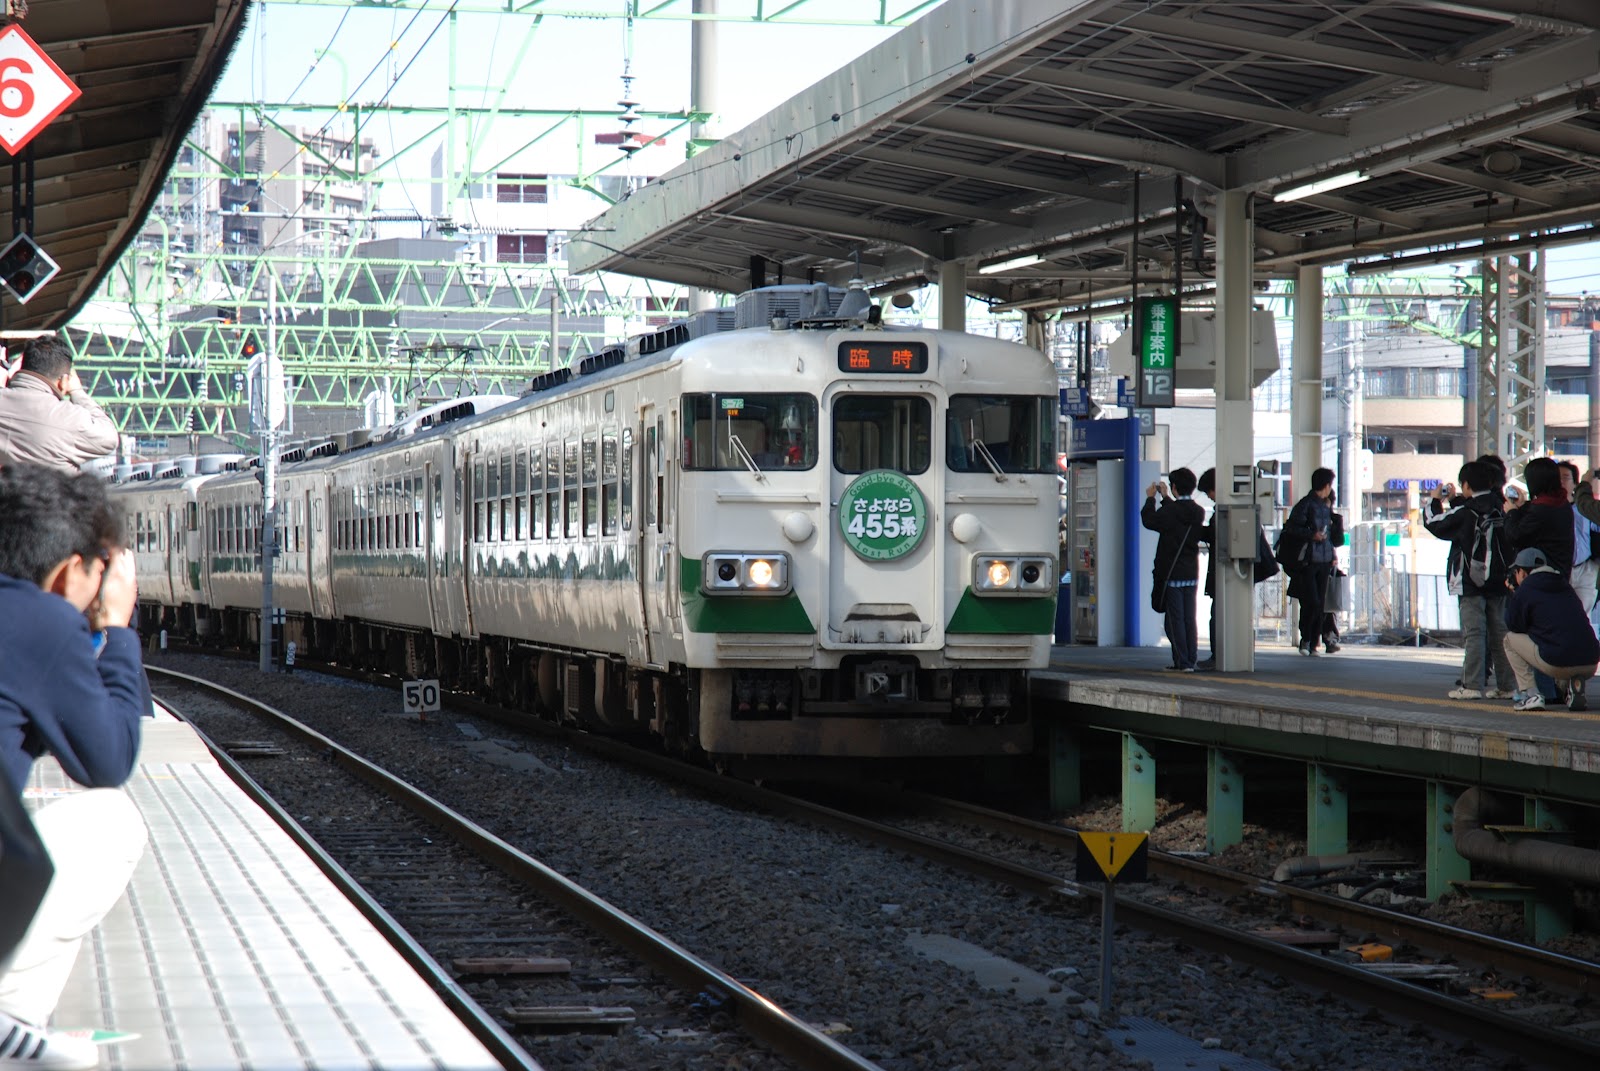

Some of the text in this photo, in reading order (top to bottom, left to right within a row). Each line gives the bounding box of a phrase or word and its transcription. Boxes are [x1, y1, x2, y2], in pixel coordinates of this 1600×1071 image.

[0, 58, 35, 118] 6
[1149, 304, 1166, 366] 乗車案内
[849, 348, 913, 369] 臨時
[1145, 374, 1170, 395] 12
[849, 473, 915, 497] Good-bye 455
[853, 497, 913, 513] さよなら
[848, 513, 918, 539] 455系
[855, 541, 911, 557] Last Run
[406, 685, 437, 708] 50
